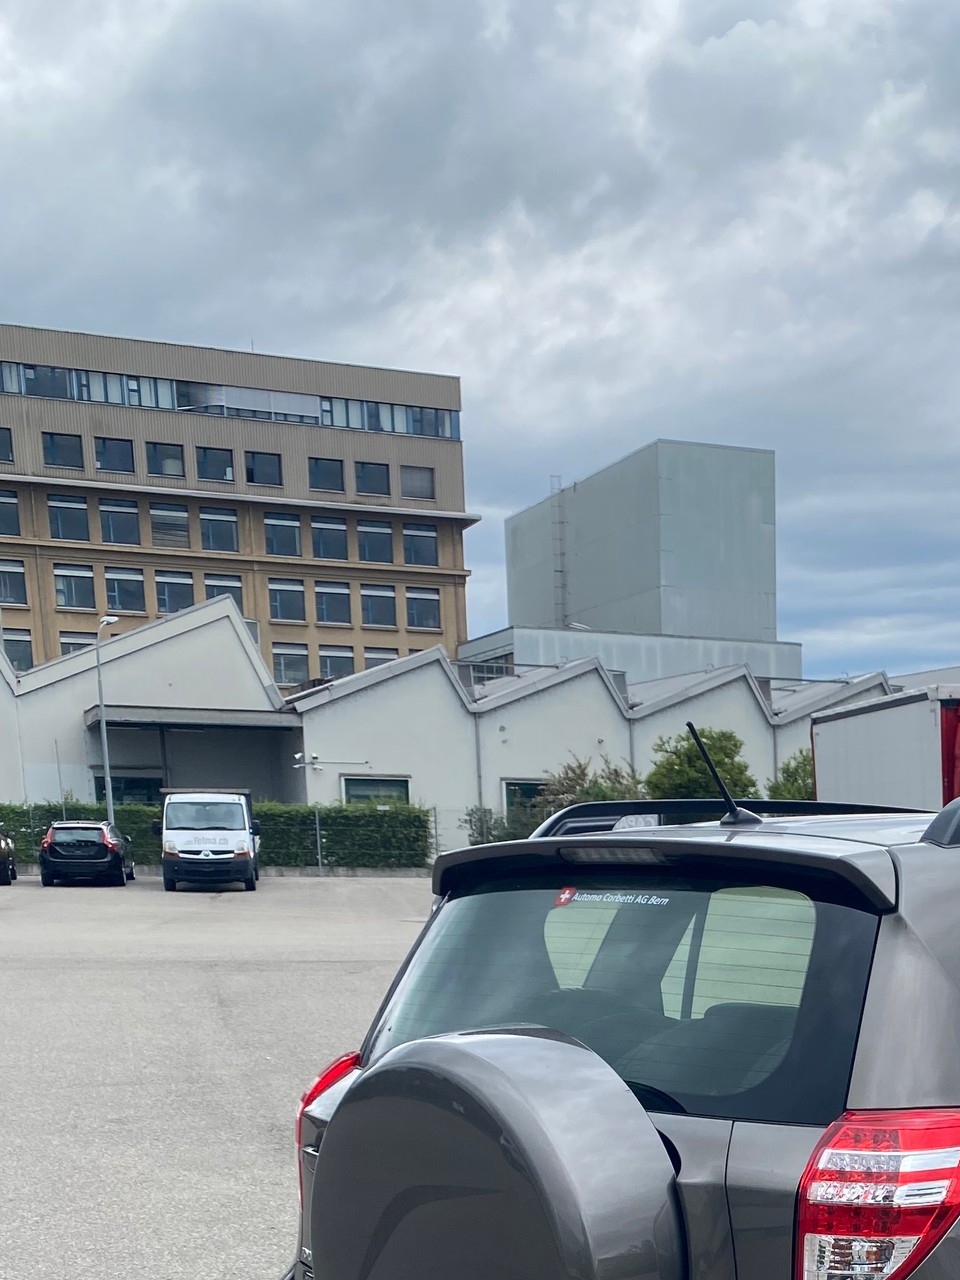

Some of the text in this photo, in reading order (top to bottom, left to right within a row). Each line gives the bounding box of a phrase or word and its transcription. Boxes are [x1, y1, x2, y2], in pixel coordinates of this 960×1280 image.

[602, 893, 635, 903] Corbetti
[634, 894, 649, 904] AG
[647, 895, 670, 905] Bern
